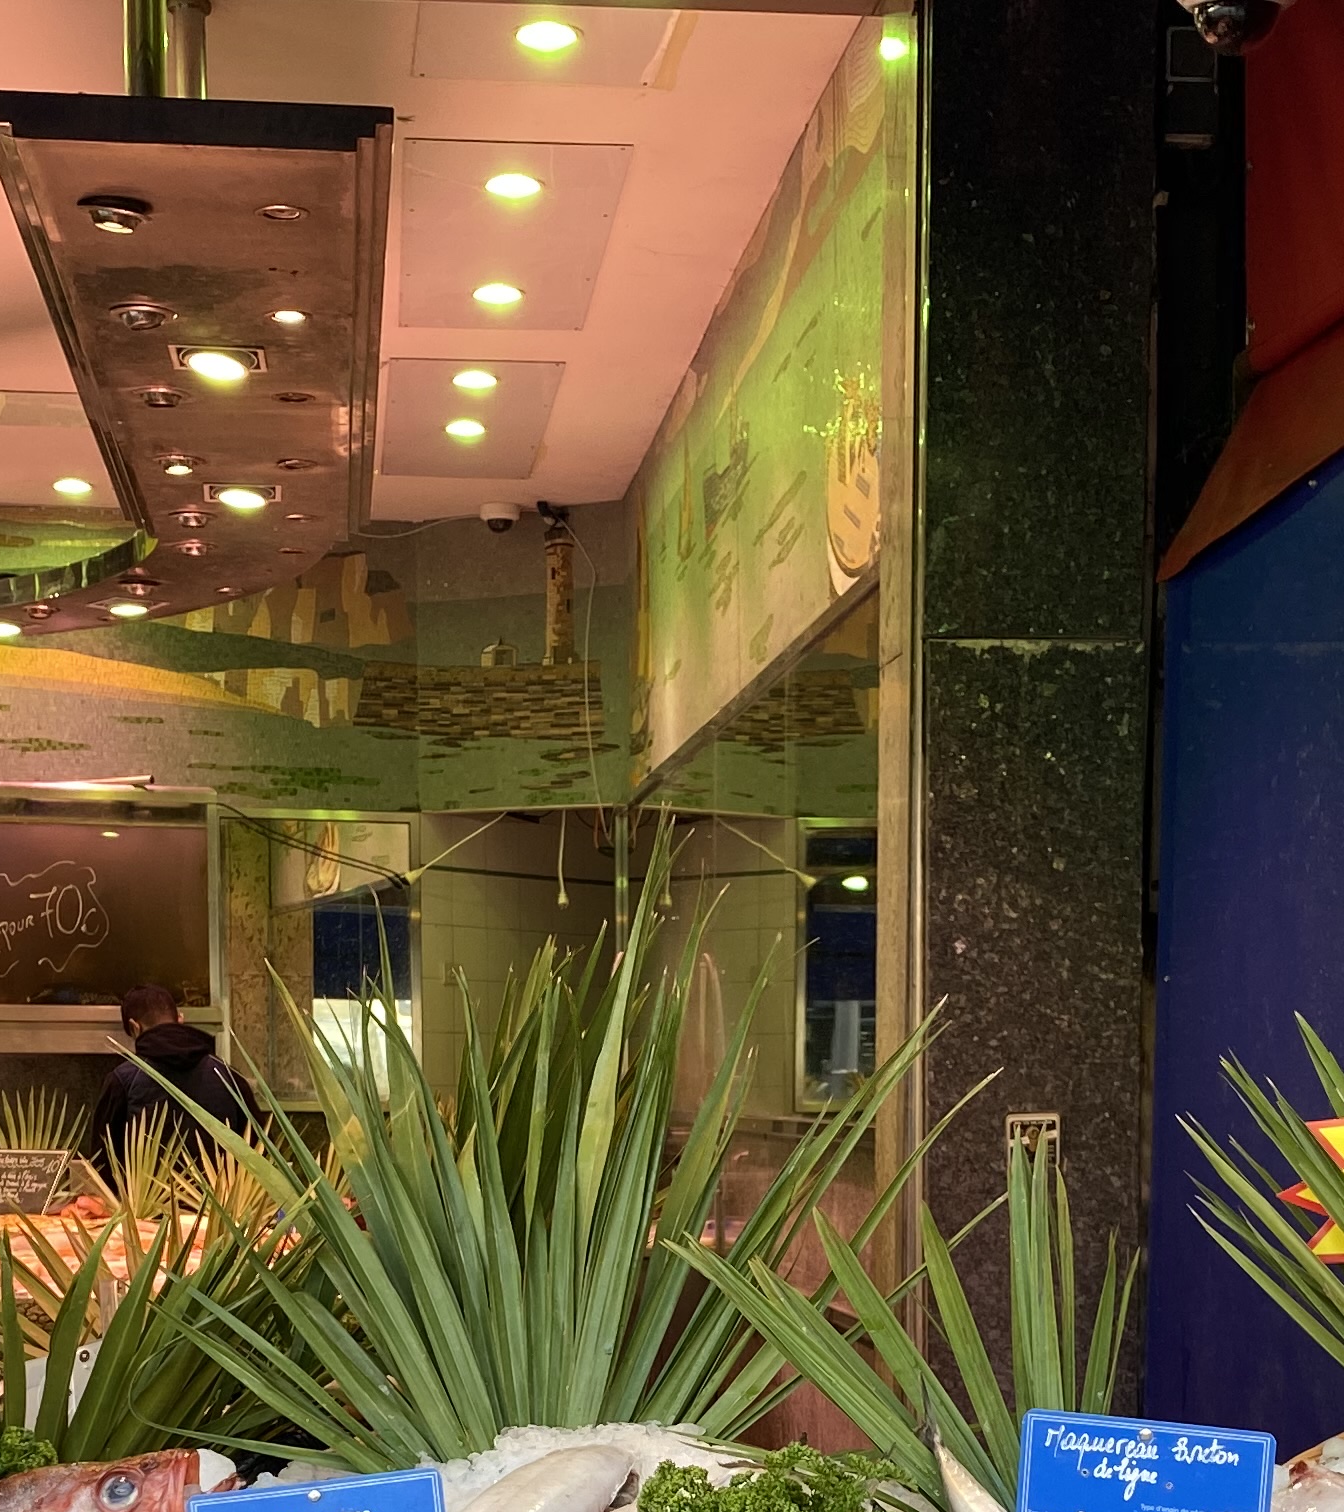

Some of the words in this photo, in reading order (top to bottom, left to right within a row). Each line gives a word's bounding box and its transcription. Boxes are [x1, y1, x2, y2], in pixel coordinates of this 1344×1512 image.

[29, 884, 83, 939] 70
[1044, 1425, 1159, 1470] Maquereau
[1172, 1437, 1240, 1466] Breton
